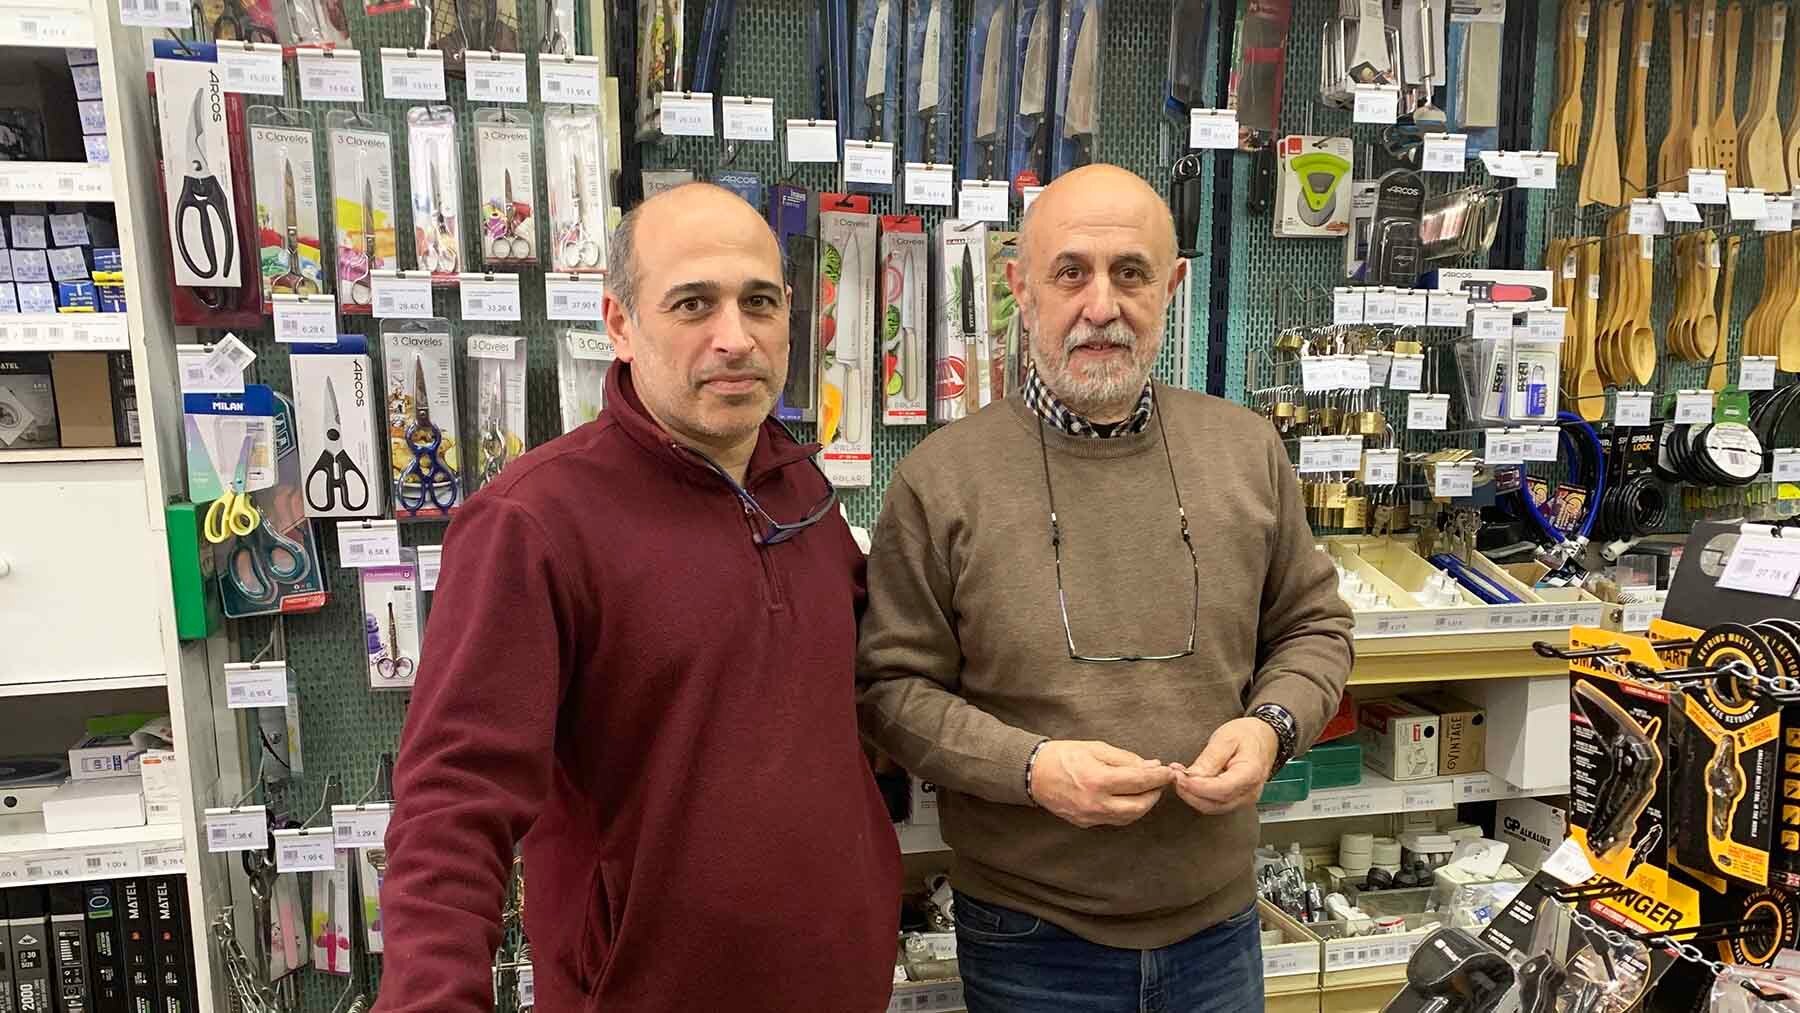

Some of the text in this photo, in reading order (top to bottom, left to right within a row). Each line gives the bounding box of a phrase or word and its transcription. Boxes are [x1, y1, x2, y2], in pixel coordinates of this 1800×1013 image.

[208, 69, 222, 122] ARCOS
[257, 131, 309, 144] 3 Claveles
[337, 135, 386, 148] 3 Claveles
[490, 131, 528, 141] Claveles
[720, 175, 758, 184] ARCOS
[1387, 186, 1419, 196] ARCOS
[1442, 271, 1473, 279] ARCOS
[392, 335, 443, 347] 3 Claveles
[353, 360, 365, 408] ARCOS
[212, 402, 244, 412] MILAN
[1632, 434, 1655, 443] SPIRAL
[1633, 443, 1651, 451] LOCK
[1450, 715, 1462, 761] VINTAGE
[1503, 816, 1552, 847] GP ALKALINE
[126, 881, 139, 919] MATEL
[157, 881, 171, 919] MATEL
[19, 983, 35, 1011] 2000
